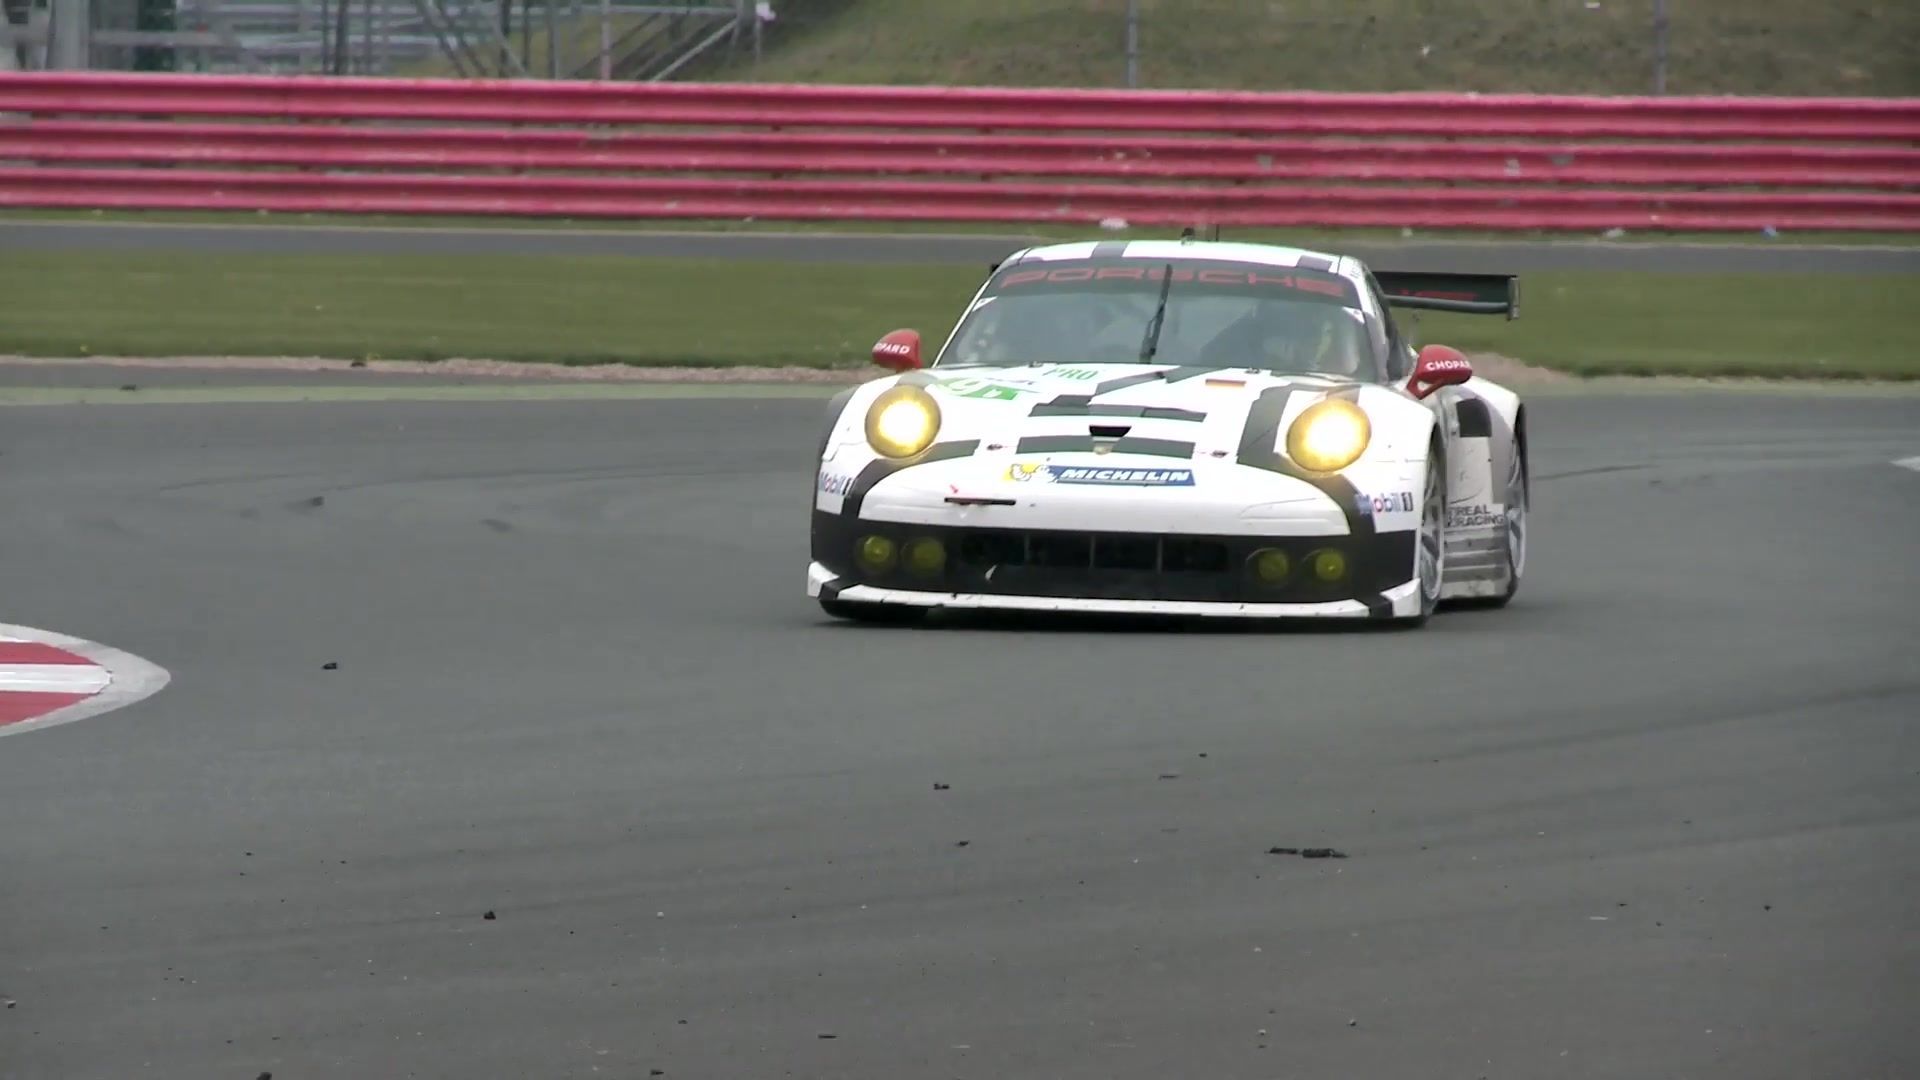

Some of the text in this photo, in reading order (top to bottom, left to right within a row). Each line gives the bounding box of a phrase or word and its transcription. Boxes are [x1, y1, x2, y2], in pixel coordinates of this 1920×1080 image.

[1001, 267, 1345, 298] PORSCHE
[1042, 367, 1099, 381] PRO
[1060, 468, 1190, 482] MICHELIN
[1356, 492, 1399, 513] Mobil
